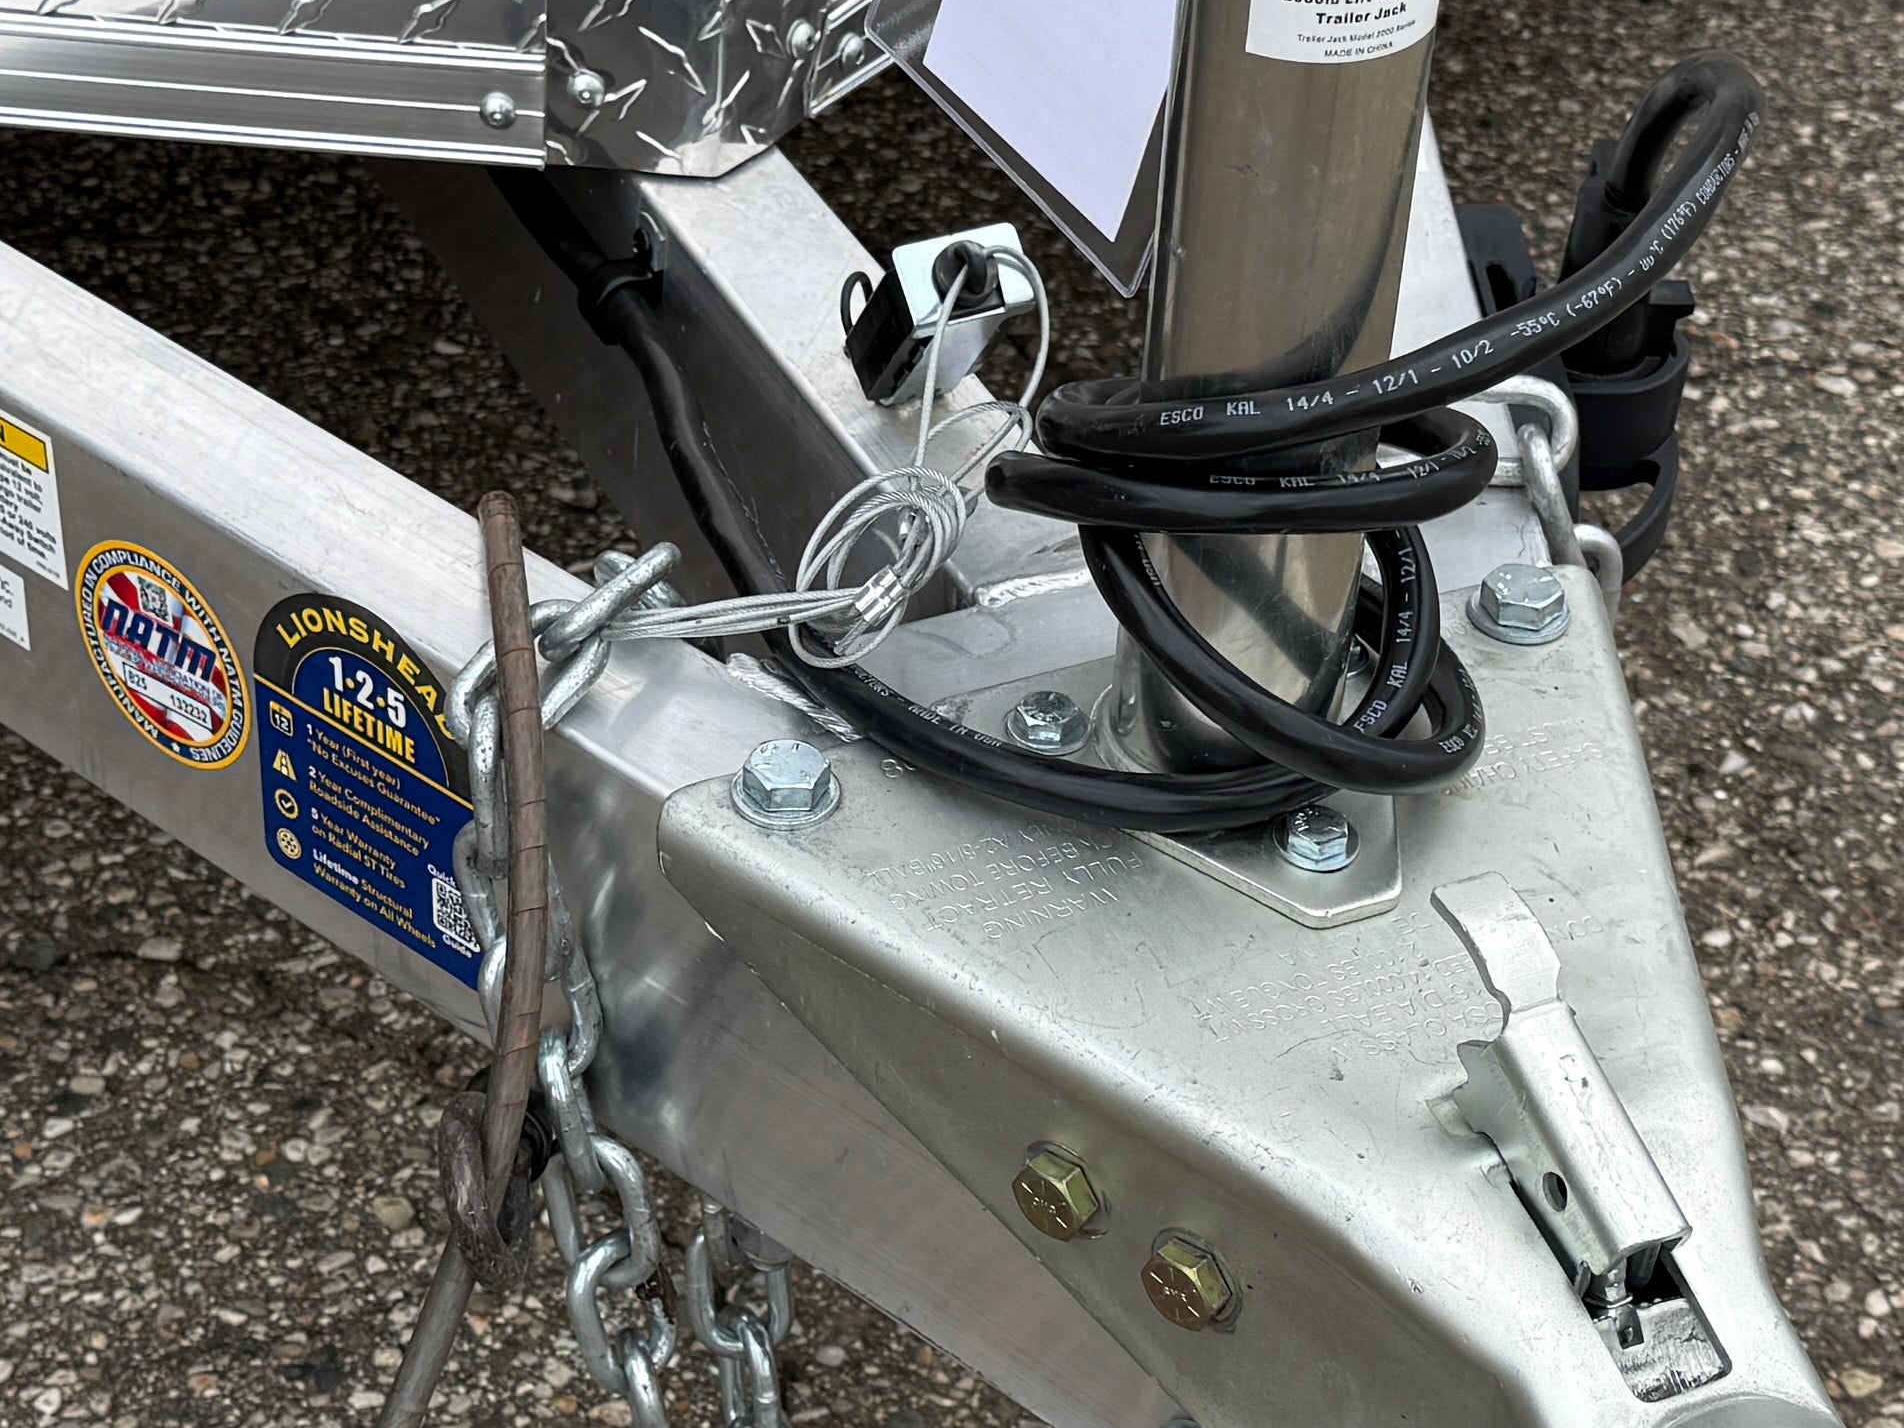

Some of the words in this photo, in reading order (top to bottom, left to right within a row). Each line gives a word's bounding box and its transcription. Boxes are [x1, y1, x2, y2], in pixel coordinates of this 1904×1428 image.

[1316, 12, 1371, 24] Trailer
[1374, 3, 1407, 20] Jack
[1324, 49, 1352, 57] MADE
[1356, 47, 1364, 55] IN
[1367, 42, 1393, 54] CHINA
[1159, 406, 1205, 427] ESCO
[1226, 400, 1261, 416] KAL
[1285, 391, 1335, 412] 14/4
[1371, 368, 1419, 395] 12/1
[1451, 340, 1494, 369] 10/2
[1696, 153, 1735, 206] CONDUCTORS
[85, 572, 98, 590] IN
[93, 549, 181, 590] COMPLIANCE
[1398, 546, 1417, 584] 12/1
[102, 598, 217, 682] NATM
[184, 590, 221, 643] WITH
[1396, 611, 1414, 644] 14/4
[82, 590, 159, 739] MANUFACTURED
[219, 647, 242, 705] NATM
[276, 607, 456, 741] LIONSHEAD
[1387, 661, 1408, 689] KAL
[190, 708, 244, 762] GUIDELINES
[273, 713, 289, 731] 12
[323, 687, 415, 764] LIFETIME
[908, 705, 942, 725] MADE
[306, 723, 312, 735] 1
[315, 728, 339, 750] Year
[341, 745, 369, 770] (First
[371, 765, 400, 789] year)
[331, 752, 374, 787] Excuses
[308, 765, 316, 778] 2
[317, 770, 342, 793] Year
[344, 788, 428, 849] Complimentary
[309, 779, 359, 819] Roadside
[361, 814, 418, 856] Assistance
[310, 807, 318, 819] 5
[320, 812, 344, 835] Year
[346, 829, 395, 869] Warranty
[311, 824, 326, 838] on
[327, 831, 361, 861] Radial
[363, 854, 377, 870] ST
[379, 864, 405, 888] Tires
[983, 837, 1080, 883] BEFORE
[312, 848, 358, 884] Lifetime
[360, 878, 412, 918] Structural
[886, 867, 985, 913] TOWING
[1059, 847, 1144, 889] FULLY
[313, 863, 362, 903] Warranty
[363, 895, 378, 910] on
[380, 902, 394, 922] All
[395, 914, 436, 948] Wheels
[920, 874, 1053, 931] RETRACT
[980, 882, 1119, 941] WARNING
[442, 934, 473, 958] Guide
